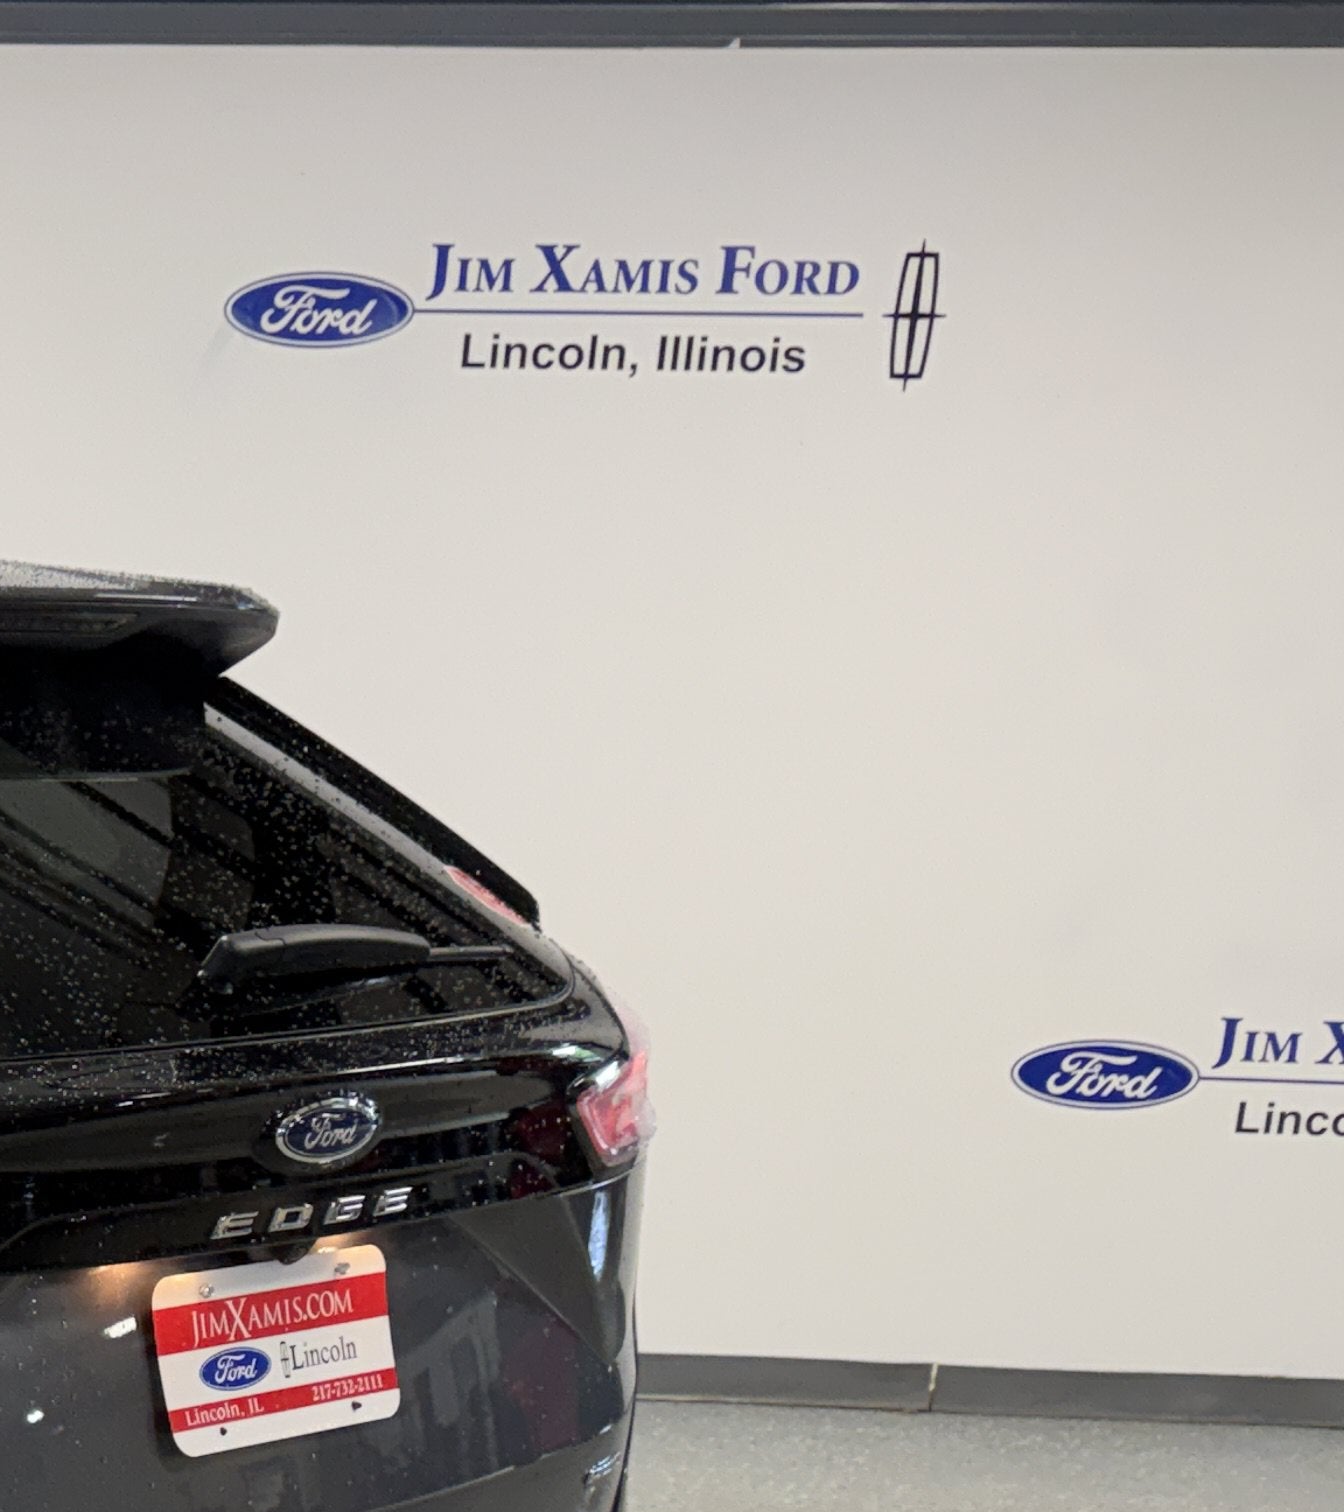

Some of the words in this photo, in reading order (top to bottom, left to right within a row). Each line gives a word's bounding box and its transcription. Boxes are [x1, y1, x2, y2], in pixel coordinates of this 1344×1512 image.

[425, 243, 515, 301] JIM
[529, 244, 699, 295] XAMIS
[715, 245, 860, 295] FORD
[260, 284, 378, 335] Ford
[461, 333, 638, 378] Lincoln,
[656, 335, 805, 373] Illinois
[1212, 1016, 1303, 1070] JIM
[1045, 1051, 1163, 1100] Ford
[304, 1113, 360, 1149] Ford
[211, 1187, 413, 1239] EDGE
[214, 1353, 258, 1384] Ford
[290, 1336, 357, 1371] Lincoln
[248, 1397, 264, 1417] IL
[312, 1373, 384, 1402] 217-732-2111
